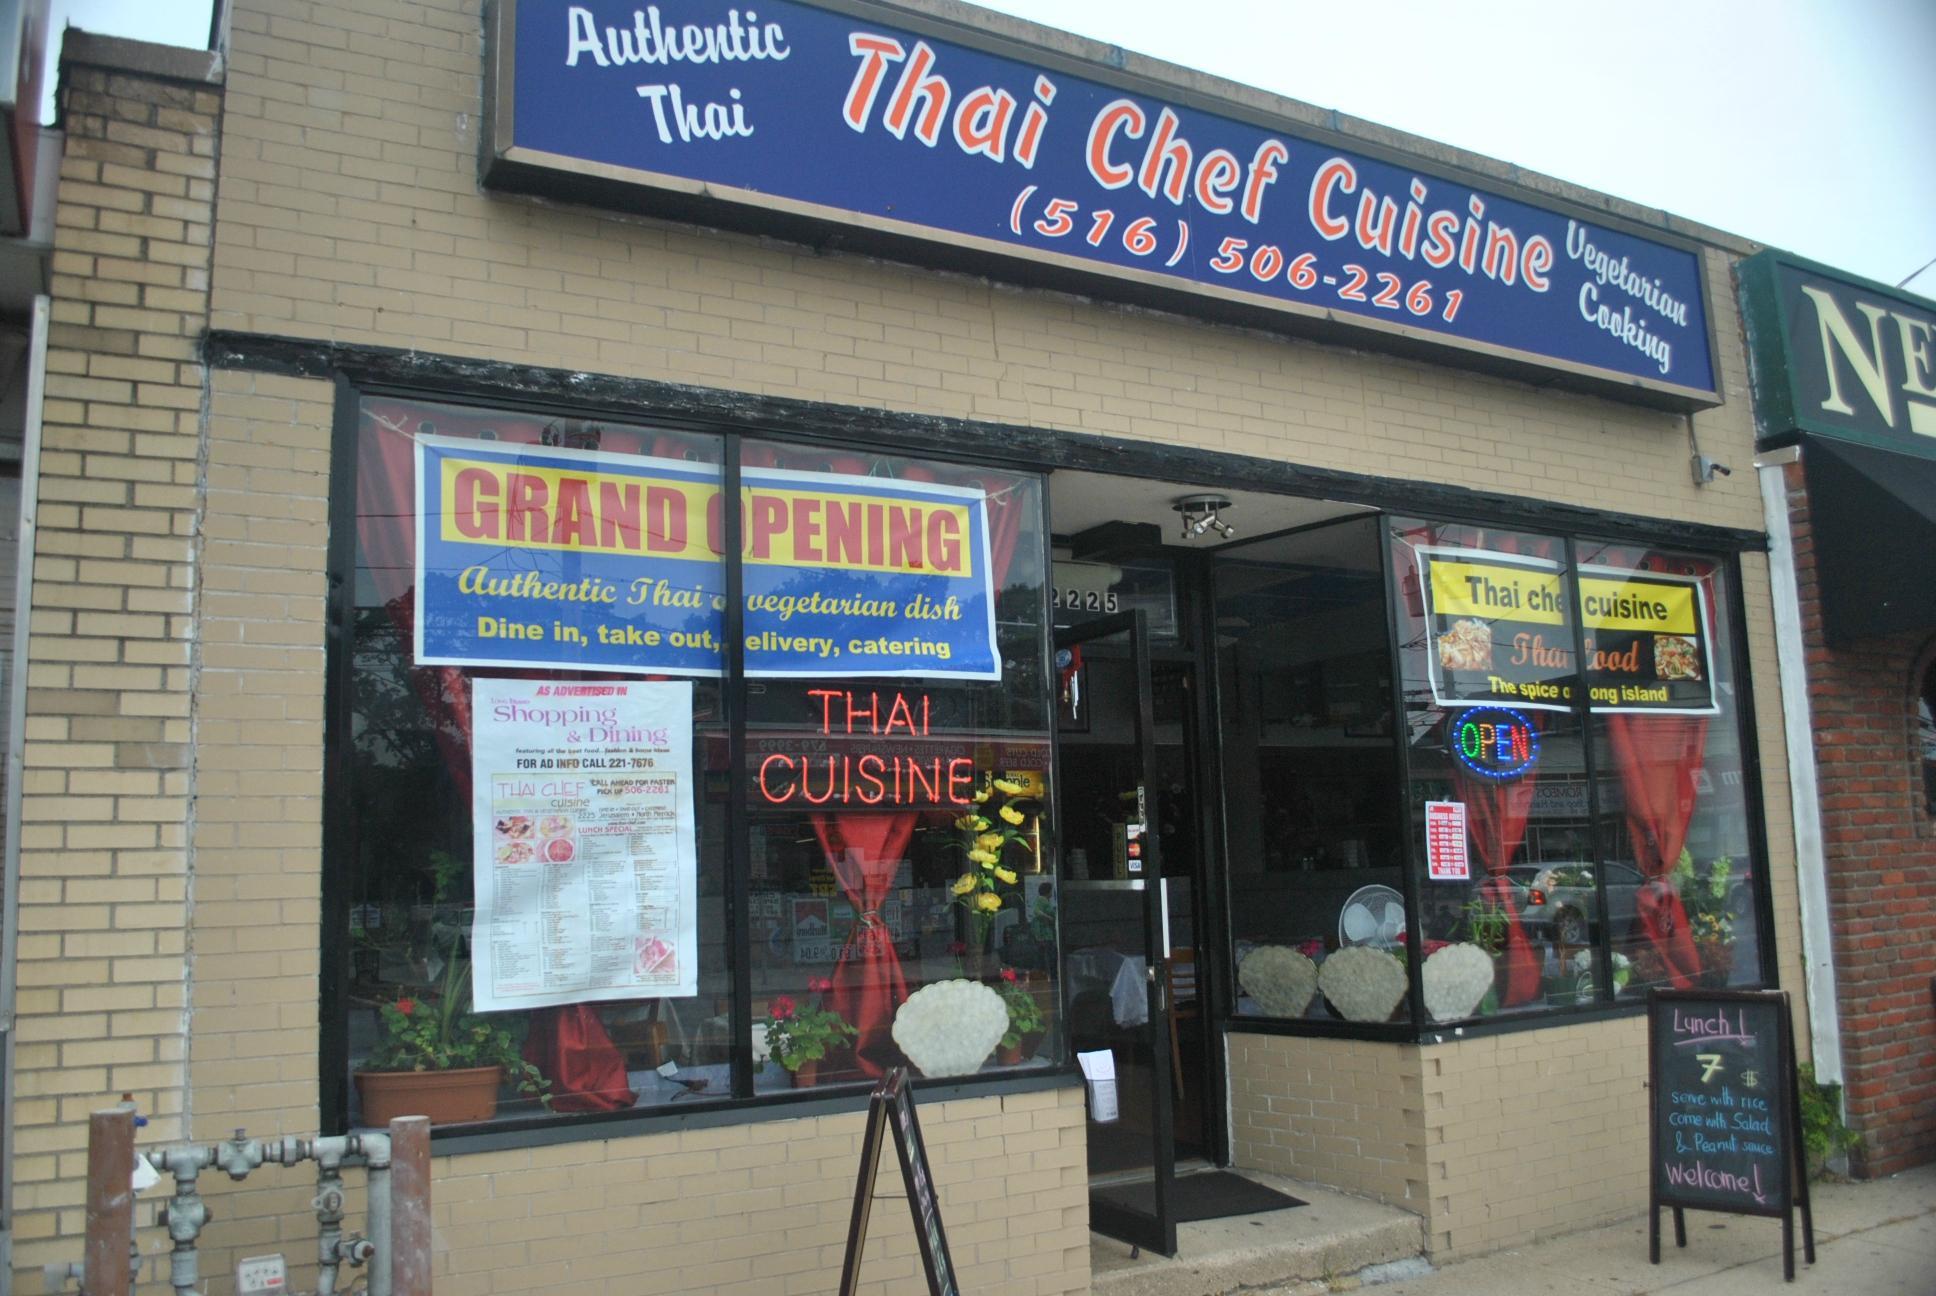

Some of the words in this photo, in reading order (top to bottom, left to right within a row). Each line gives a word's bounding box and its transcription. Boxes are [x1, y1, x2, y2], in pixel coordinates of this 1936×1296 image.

[566, 6, 791, 67] Authentic
[636, 84, 754, 144] Thai
[842, 32, 1057, 169] Thai
[1086, 98, 1289, 224] Chef
[1309, 157, 1554, 293] Cuisine
[1009, 185, 1188, 267] (516)
[1209, 238, 1464, 324] 506-2261
[1565, 220, 1688, 327] Vegetarian
[1579, 283, 1672, 374] Cooking
[1801, 285, 1936, 428] NE
[453, 467, 687, 554] GRAND
[706, 492, 961, 572] OPENING
[458, 565, 617, 603] Authentic
[626, 579, 704, 608] Thai
[747, 592, 897, 620] vegetarian
[904, 594, 962, 623] dish
[1052, 588, 1117, 612] 2225
[1465, 575, 1519, 609] Thai
[1527, 584, 1563, 613] che
[1584, 592, 1668, 621] cuisine
[478, 617, 543, 641] Dine
[553, 620, 588, 647] in,
[598, 623, 662, 646] take
[669, 629, 720, 654] out,
[744, 631, 840, 659] elivery,
[848, 637, 952, 660] catering
[536, 686, 551, 697] AS
[553, 686, 614, 697] ADVERTISED
[616, 686, 628, 696] IN
[1488, 676, 1517, 694] The
[1519, 682, 1559, 700] spice
[1563, 687, 1571, 699] o
[1588, 685, 1618, 704] ong
[1622, 685, 1668, 702] island
[493, 705, 618, 726] Shopping
[807, 689, 929, 736] THAI
[566, 729, 581, 743] &
[589, 726, 668, 746] Dining
[1460, 722, 1531, 762] OPEN
[517, 758, 537, 769] FOR
[540, 758, 553, 769] AD
[556, 758, 580, 769] INFO
[582, 758, 607, 769] CALL
[609, 758, 655, 768] 221-7676
[760, 754, 974, 804] CUISINE
[497, 780, 536, 799] THAI
[541, 780, 586, 799] CHEF
[551, 798, 590, 808] cuisine
[578, 826, 603, 834] LUNCH
[604, 825, 633, 833] SPECIAL
[1696, 1054, 1725, 1083] 7
[1711, 1086, 1734, 1106] with
[1741, 1095, 1768, 1111] rice
[1669, 1112, 1701, 1126] come
[1705, 1112, 1726, 1129] with
[1731, 1112, 1771, 1135] Salad
[1694, 1132, 1737, 1152] Peanut
[1742, 1139, 1774, 1154] sauce
